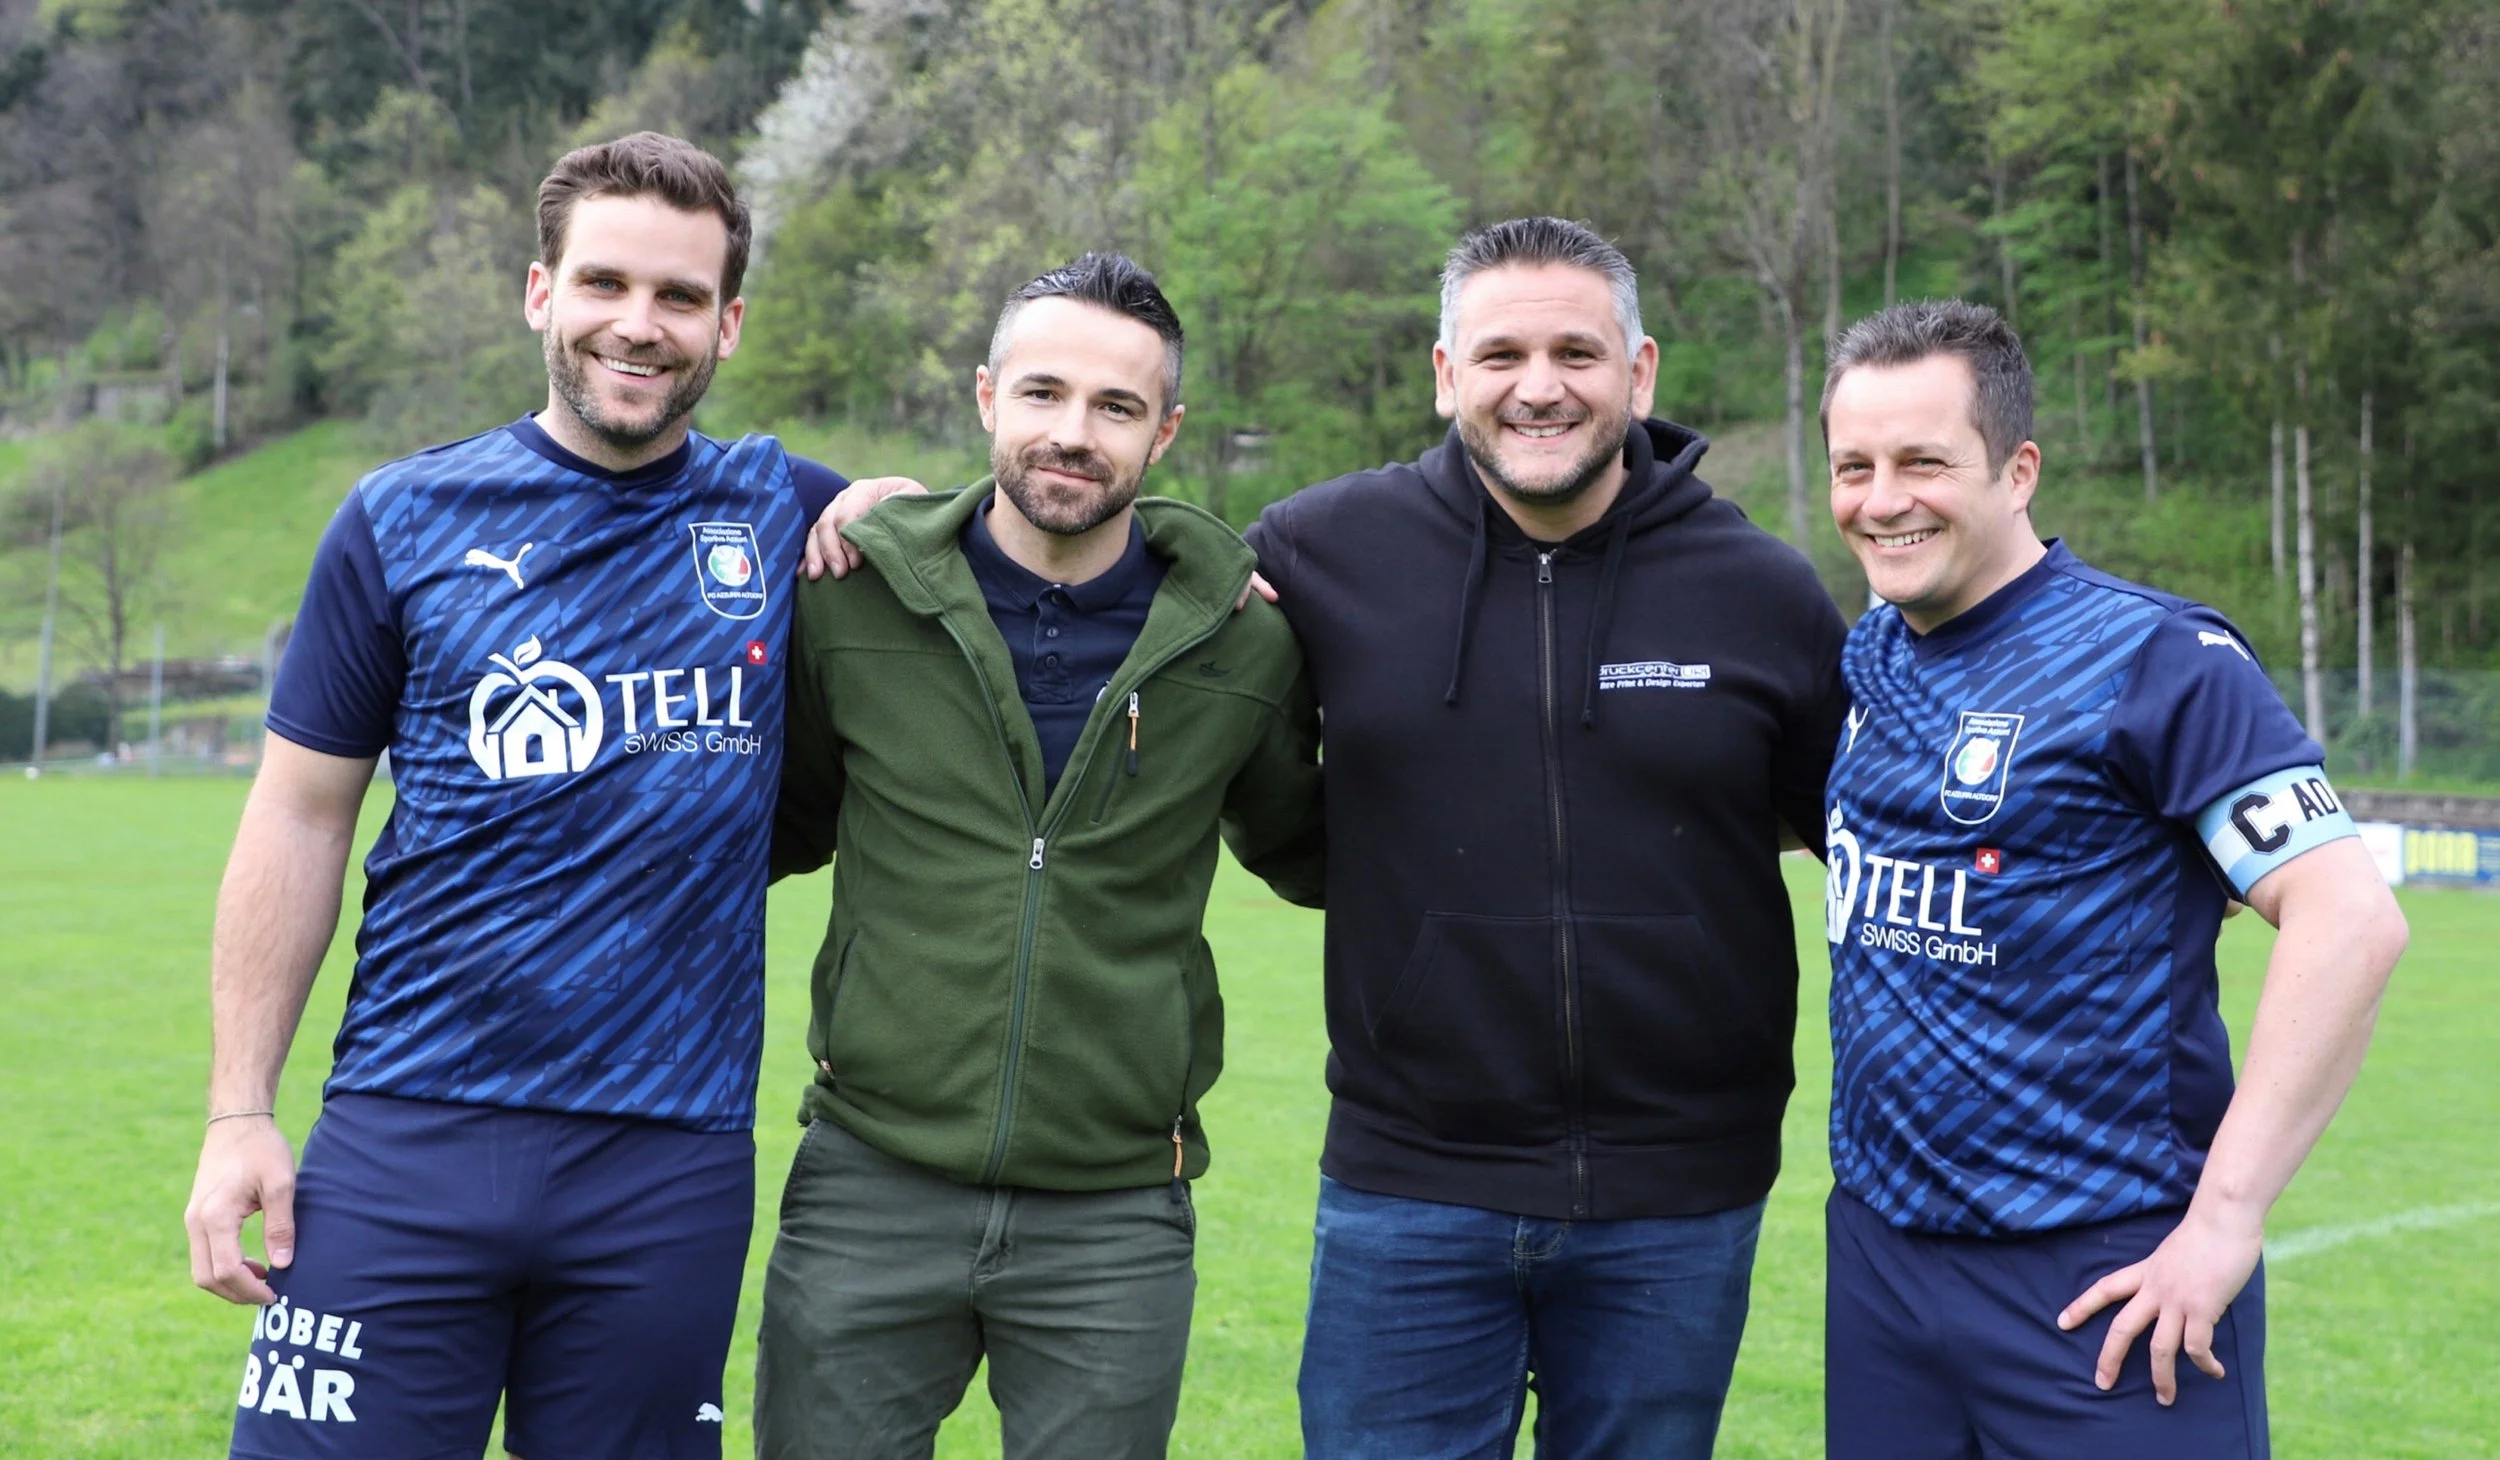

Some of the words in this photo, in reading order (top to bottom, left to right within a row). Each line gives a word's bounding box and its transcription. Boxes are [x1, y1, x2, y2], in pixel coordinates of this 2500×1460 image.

[605, 666, 753, 734] TELL
[624, 730, 698, 754] SWISS
[704, 730, 762, 755] GmbH
[2228, 788, 2293, 856] C
[1864, 853, 1982, 936] TELL
[1860, 922, 1921, 955] SWISS
[1925, 935, 1997, 966] GmbH
[238, 1350, 357, 1422] BÄR
